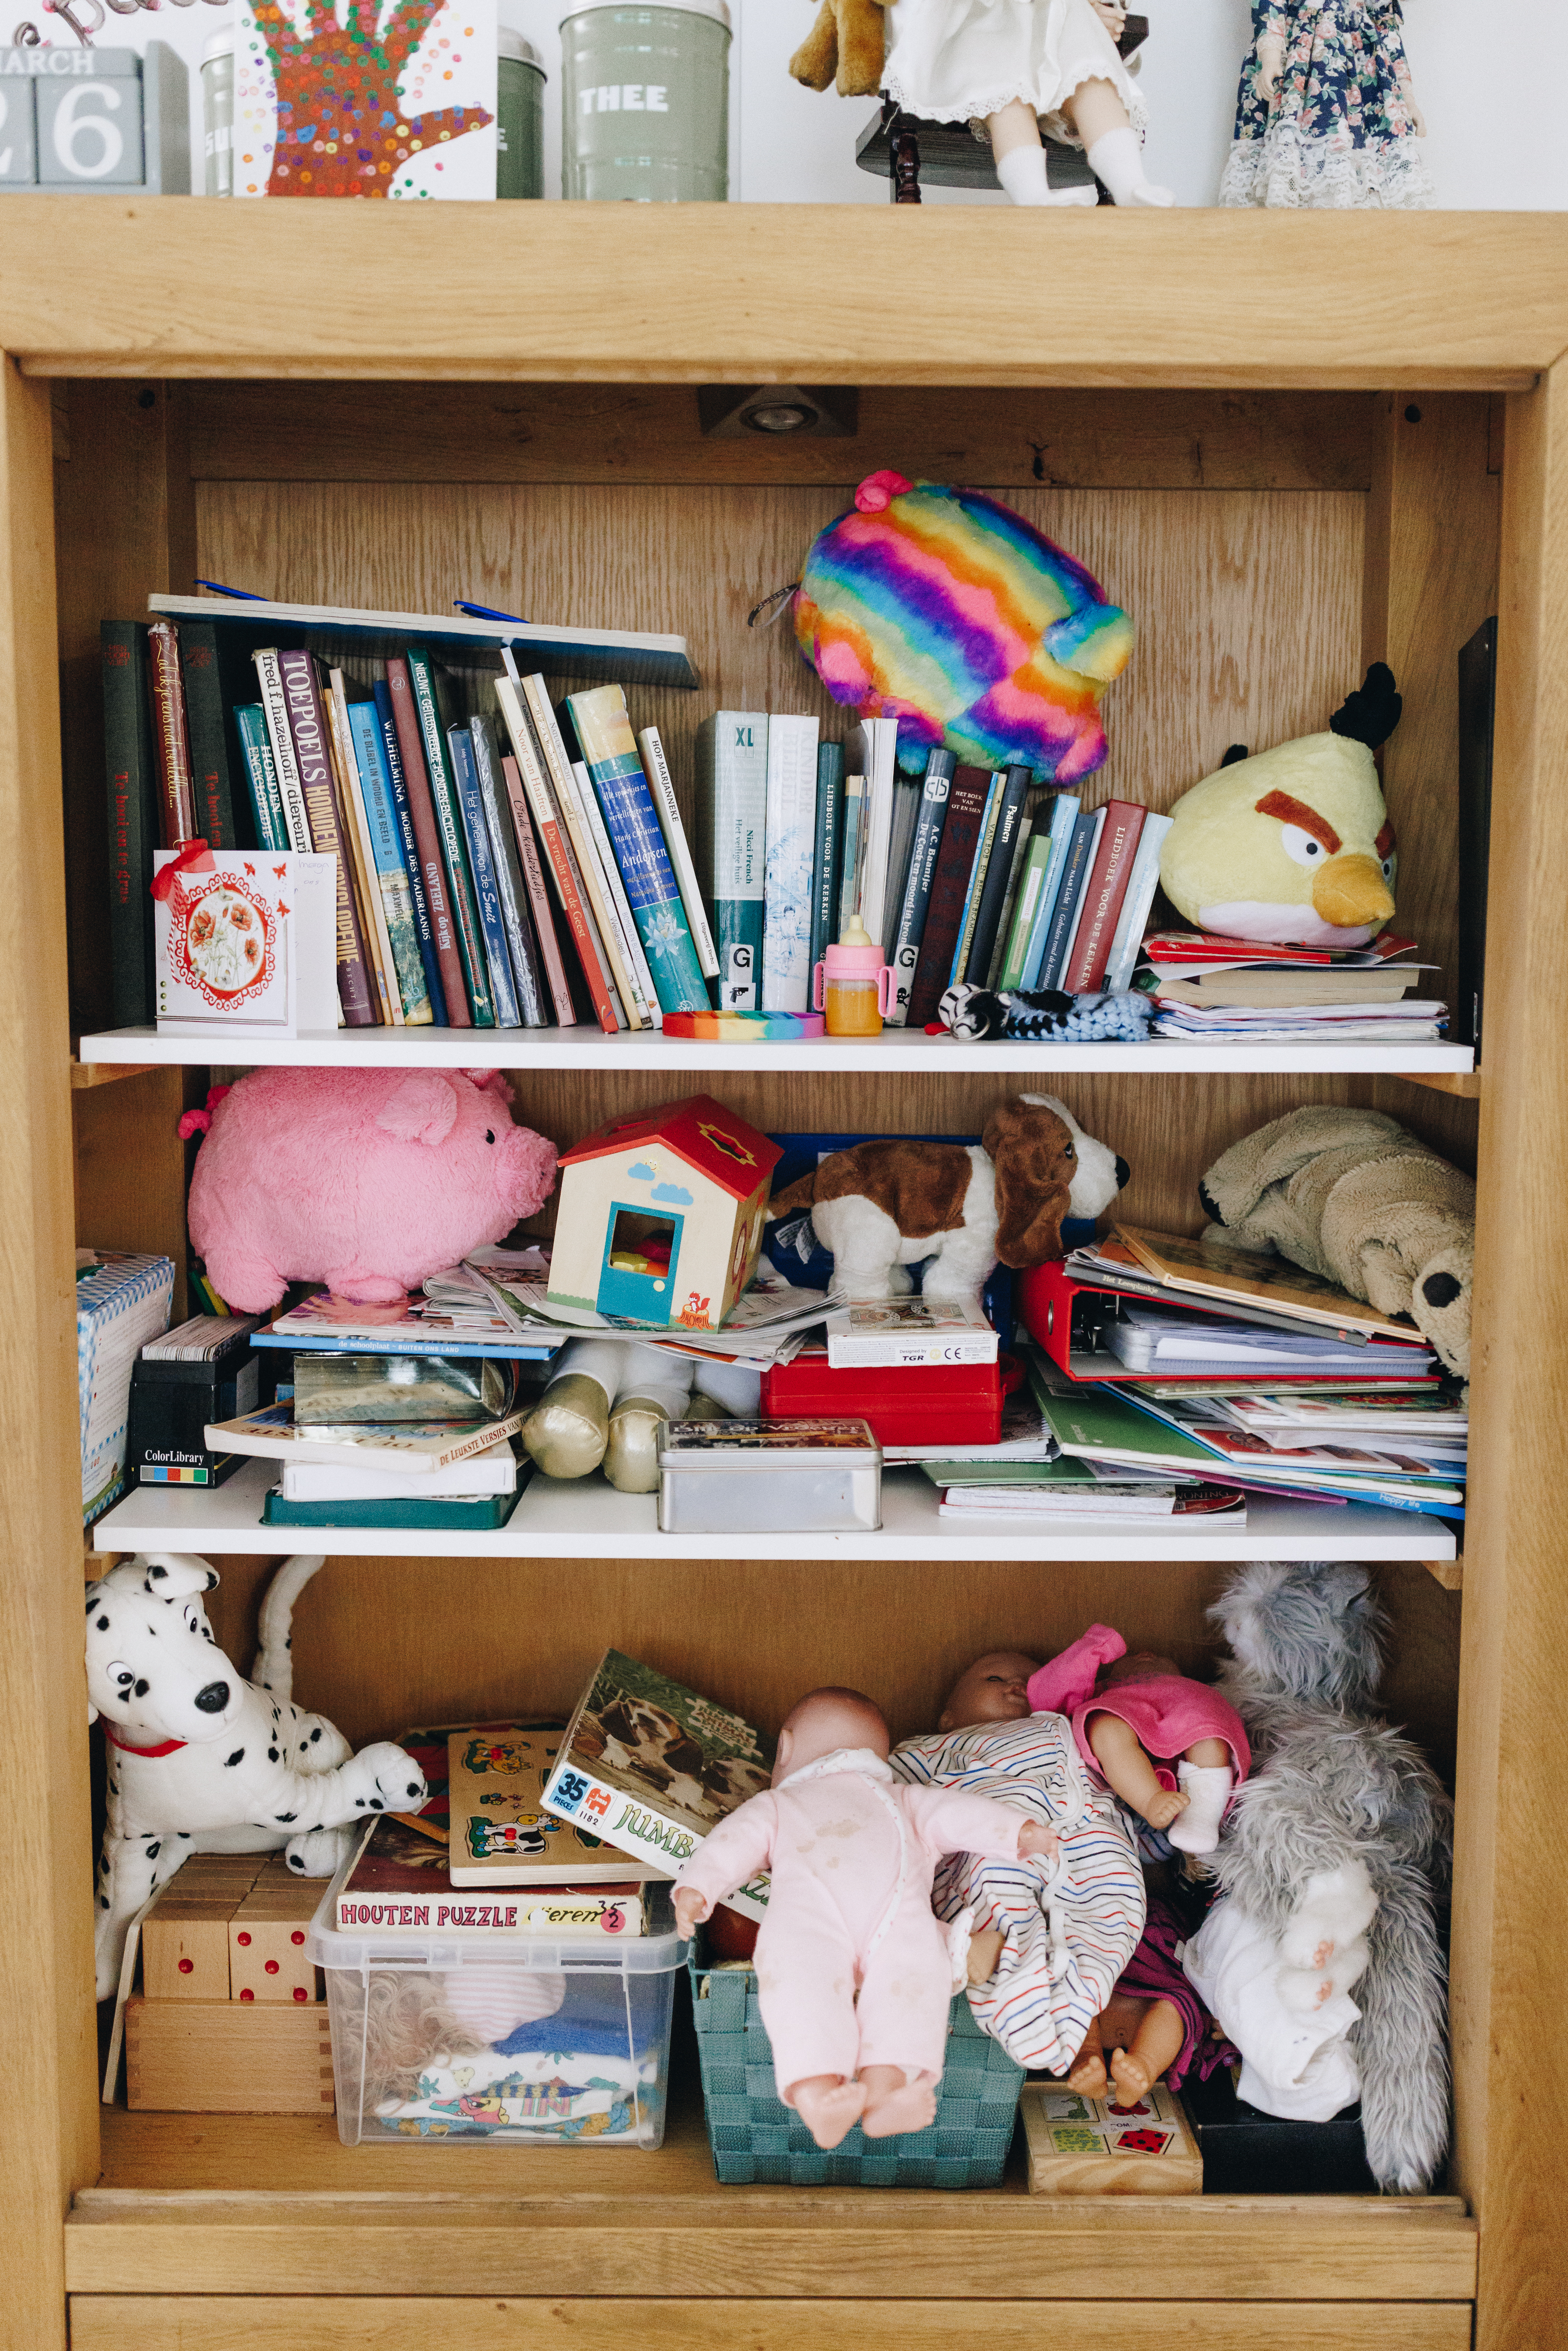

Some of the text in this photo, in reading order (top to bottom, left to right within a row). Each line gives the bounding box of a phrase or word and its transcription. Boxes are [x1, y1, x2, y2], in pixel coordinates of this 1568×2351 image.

[0, 49, 96, 74] ARCH
[580, 84, 668, 115] THEE
[414, 662, 429, 696] NIEUWE
[283, 655, 328, 783] TOEPOELS
[735, 727, 754, 747] XL
[262, 655, 281, 687] fred
[272, 704, 298, 781] hazelhoff
[287, 788, 311, 854] dierenri
[115, 771, 129, 790] Te
[261, 745, 283, 814] HONDEN
[516, 727, 548, 816] Noor van Haaften
[652, 740, 679, 822] HOP MARJANNEKE
[248, 746, 273, 839] ENCYCLOPEDIE
[364, 740, 376, 767] BIJBEL
[372, 779, 383, 806] WOORD
[380, 821, 390, 843] BEELD
[116, 795, 130, 827] hooi
[205, 771, 223, 847] Te hooi en
[514, 800, 529, 830] Oude
[825, 784, 833, 831] LIEDBOEK
[117, 830, 127, 847] en
[383, 720, 431, 941] WILHELMINA MOEDER DES VADERLANDS
[615, 833, 631, 843] Hans
[986, 823, 996, 843] VAN
[1001, 805, 1018, 843] Psalmen
[598, 830, 609, 853] DE
[733, 835, 742, 864] veilige
[983, 843, 992, 860] BOB
[467, 791, 496, 924] Het geheim van de Smit
[622, 847, 667, 868] Andersen
[921, 824, 940, 893] A.C. Baantjer
[980, 864, 987, 876] EN
[1071, 844, 1083, 869] Donker
[546, 827, 586, 938] De vrucht van de Geest
[603, 856, 626, 906] NATUUR
[823, 866, 831, 878] DE
[901, 822, 929, 944] De Cock en moord in bron
[1067, 869, 1075, 886] NAAR
[390, 884, 404, 921] MAXWELL
[425, 862, 451, 950] Kijk op ZEELAND
[822, 884, 830, 921] KERKEN
[974, 894, 981, 904] EN
[1024, 870, 1040, 917] Levenskracht
[1063, 888, 1072, 904] Licht
[1080, 827, 1125, 988] LIEDBOEK VOOR DE KERKEN
[609, 916, 627, 955] Weilanden
[701, 922, 711, 948] Uitgeverij
[964, 905, 977, 951] BRAMMETJE
[1054, 913, 1066, 941] Gebeden
[622, 912, 645, 973] BOMEN EN BLADEREN
[1050, 940, 1060, 955] rond
[733, 947, 751, 968] G
[899, 947, 916, 968] G
[346, 968, 356, 999] BECHT
[1043, 964, 1054, 989] kerststal
[1103, 1274, 1159, 1294] Het Leesplankje
[350, 1341, 390, 1350] schoolplaat
[944, 1348, 962, 1360] CE
[144, 1448, 204, 1465] ColorLibrary
[439, 1419, 520, 1465] DE LEUKSTE VERSJES VAN
[1379, 1492, 1420, 1508] Happy life
[558, 1773, 589, 1802] 35
[553, 1795, 574, 1811] PIECES
[579, 1810, 599, 1826] 1182
[612, 1804, 698, 1860] JUMB
[341, 1904, 600, 1927] HOUTEN PUZZLE eren
[609, 1914, 619, 1928] 2
